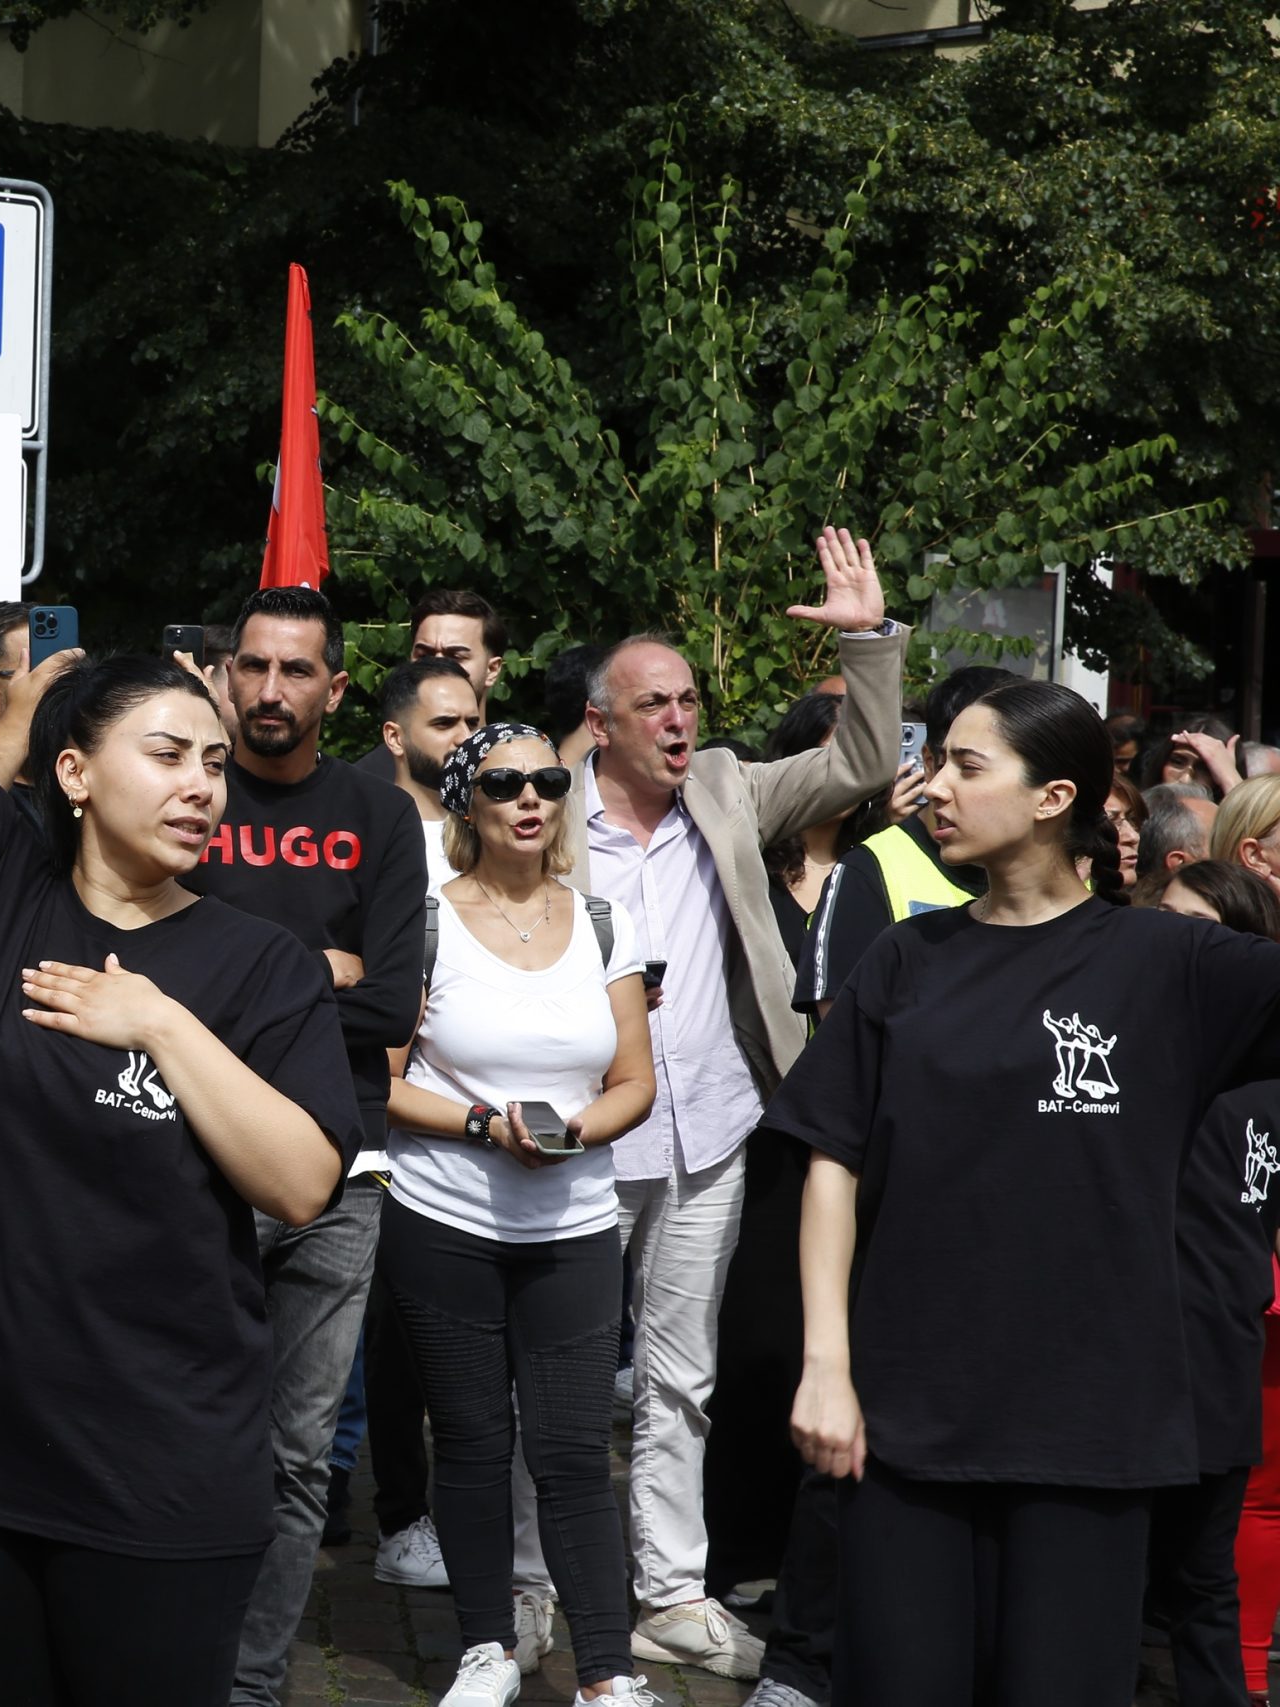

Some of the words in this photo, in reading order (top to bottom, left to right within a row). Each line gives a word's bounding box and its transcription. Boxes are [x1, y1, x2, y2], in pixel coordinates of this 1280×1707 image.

[197, 823, 362, 871] HUGO
[94, 1088, 177, 1122] BAT-Cemevi
[1037, 1099, 1120, 1114] BAT-Cemevi
